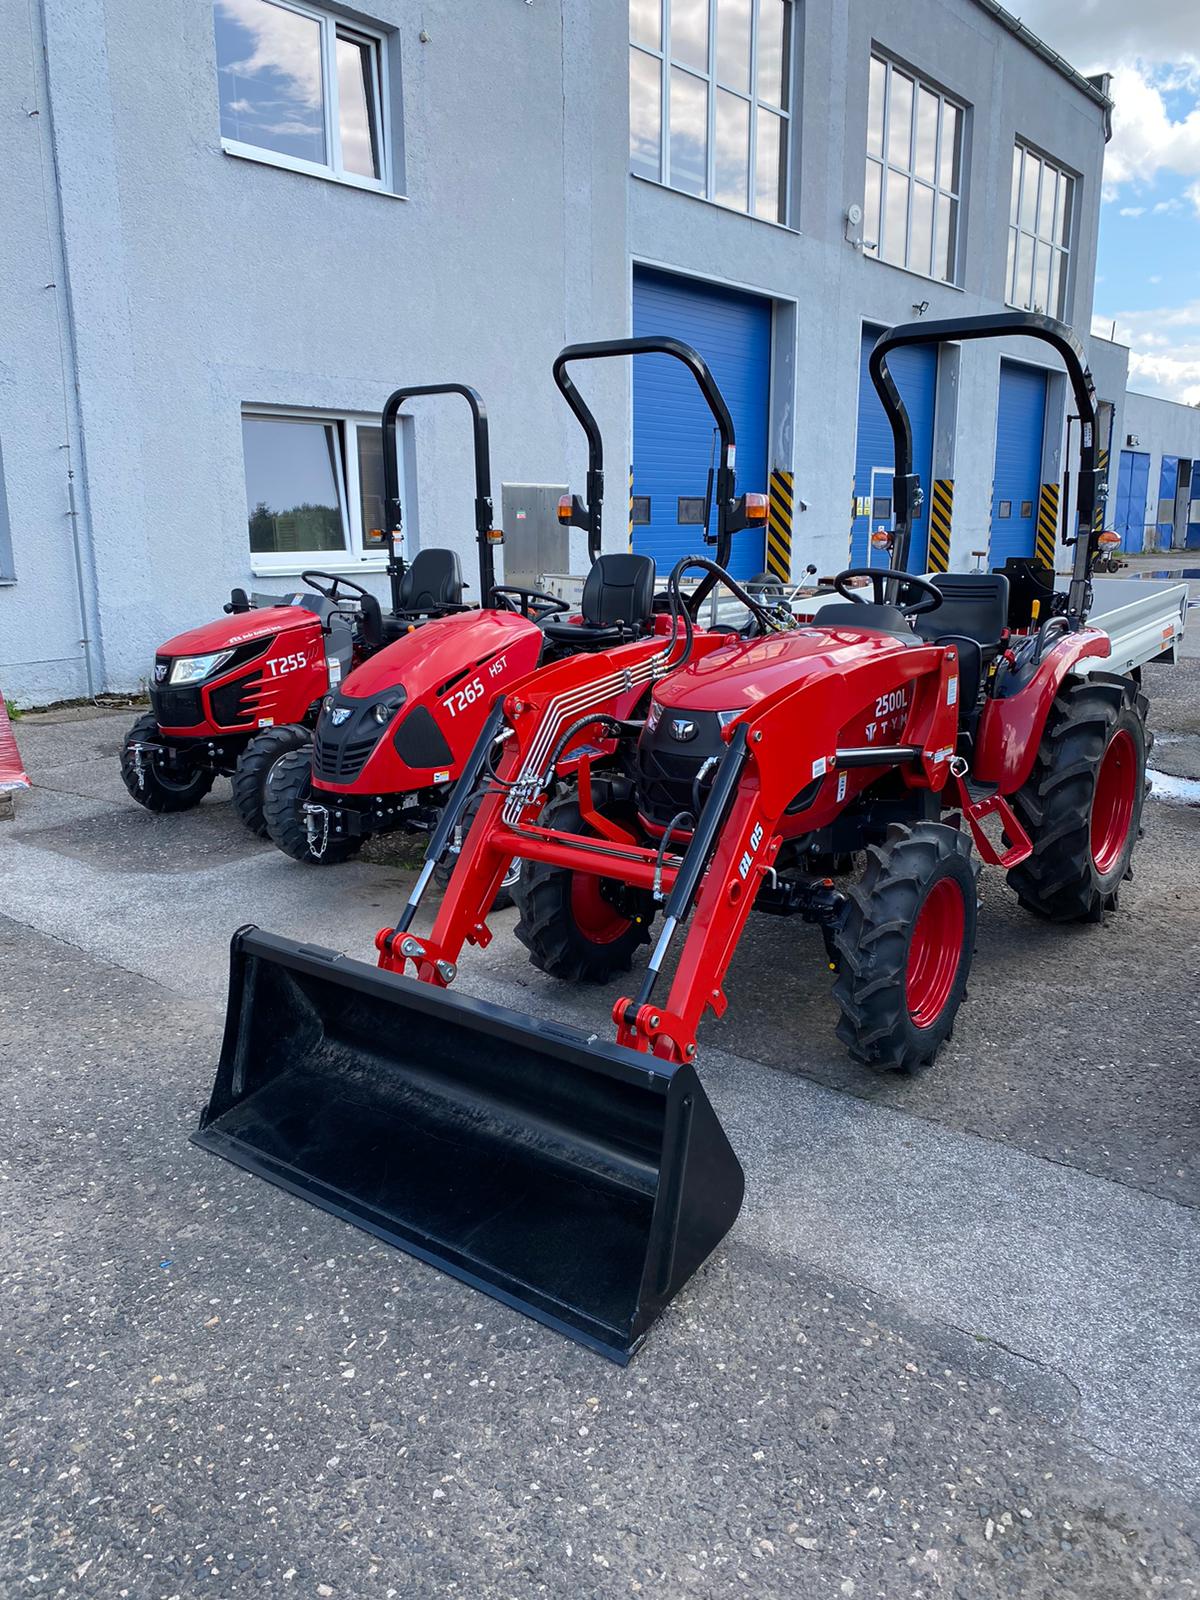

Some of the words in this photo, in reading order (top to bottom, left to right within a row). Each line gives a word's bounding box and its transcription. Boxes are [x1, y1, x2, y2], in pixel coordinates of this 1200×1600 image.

[266, 652, 307, 676] T255
[443, 677, 484, 717] T265
[488, 655, 507, 678] HST
[875, 688, 908, 717] 2500L
[738, 851, 754, 880] BL
[750, 821, 763, 852] 05
